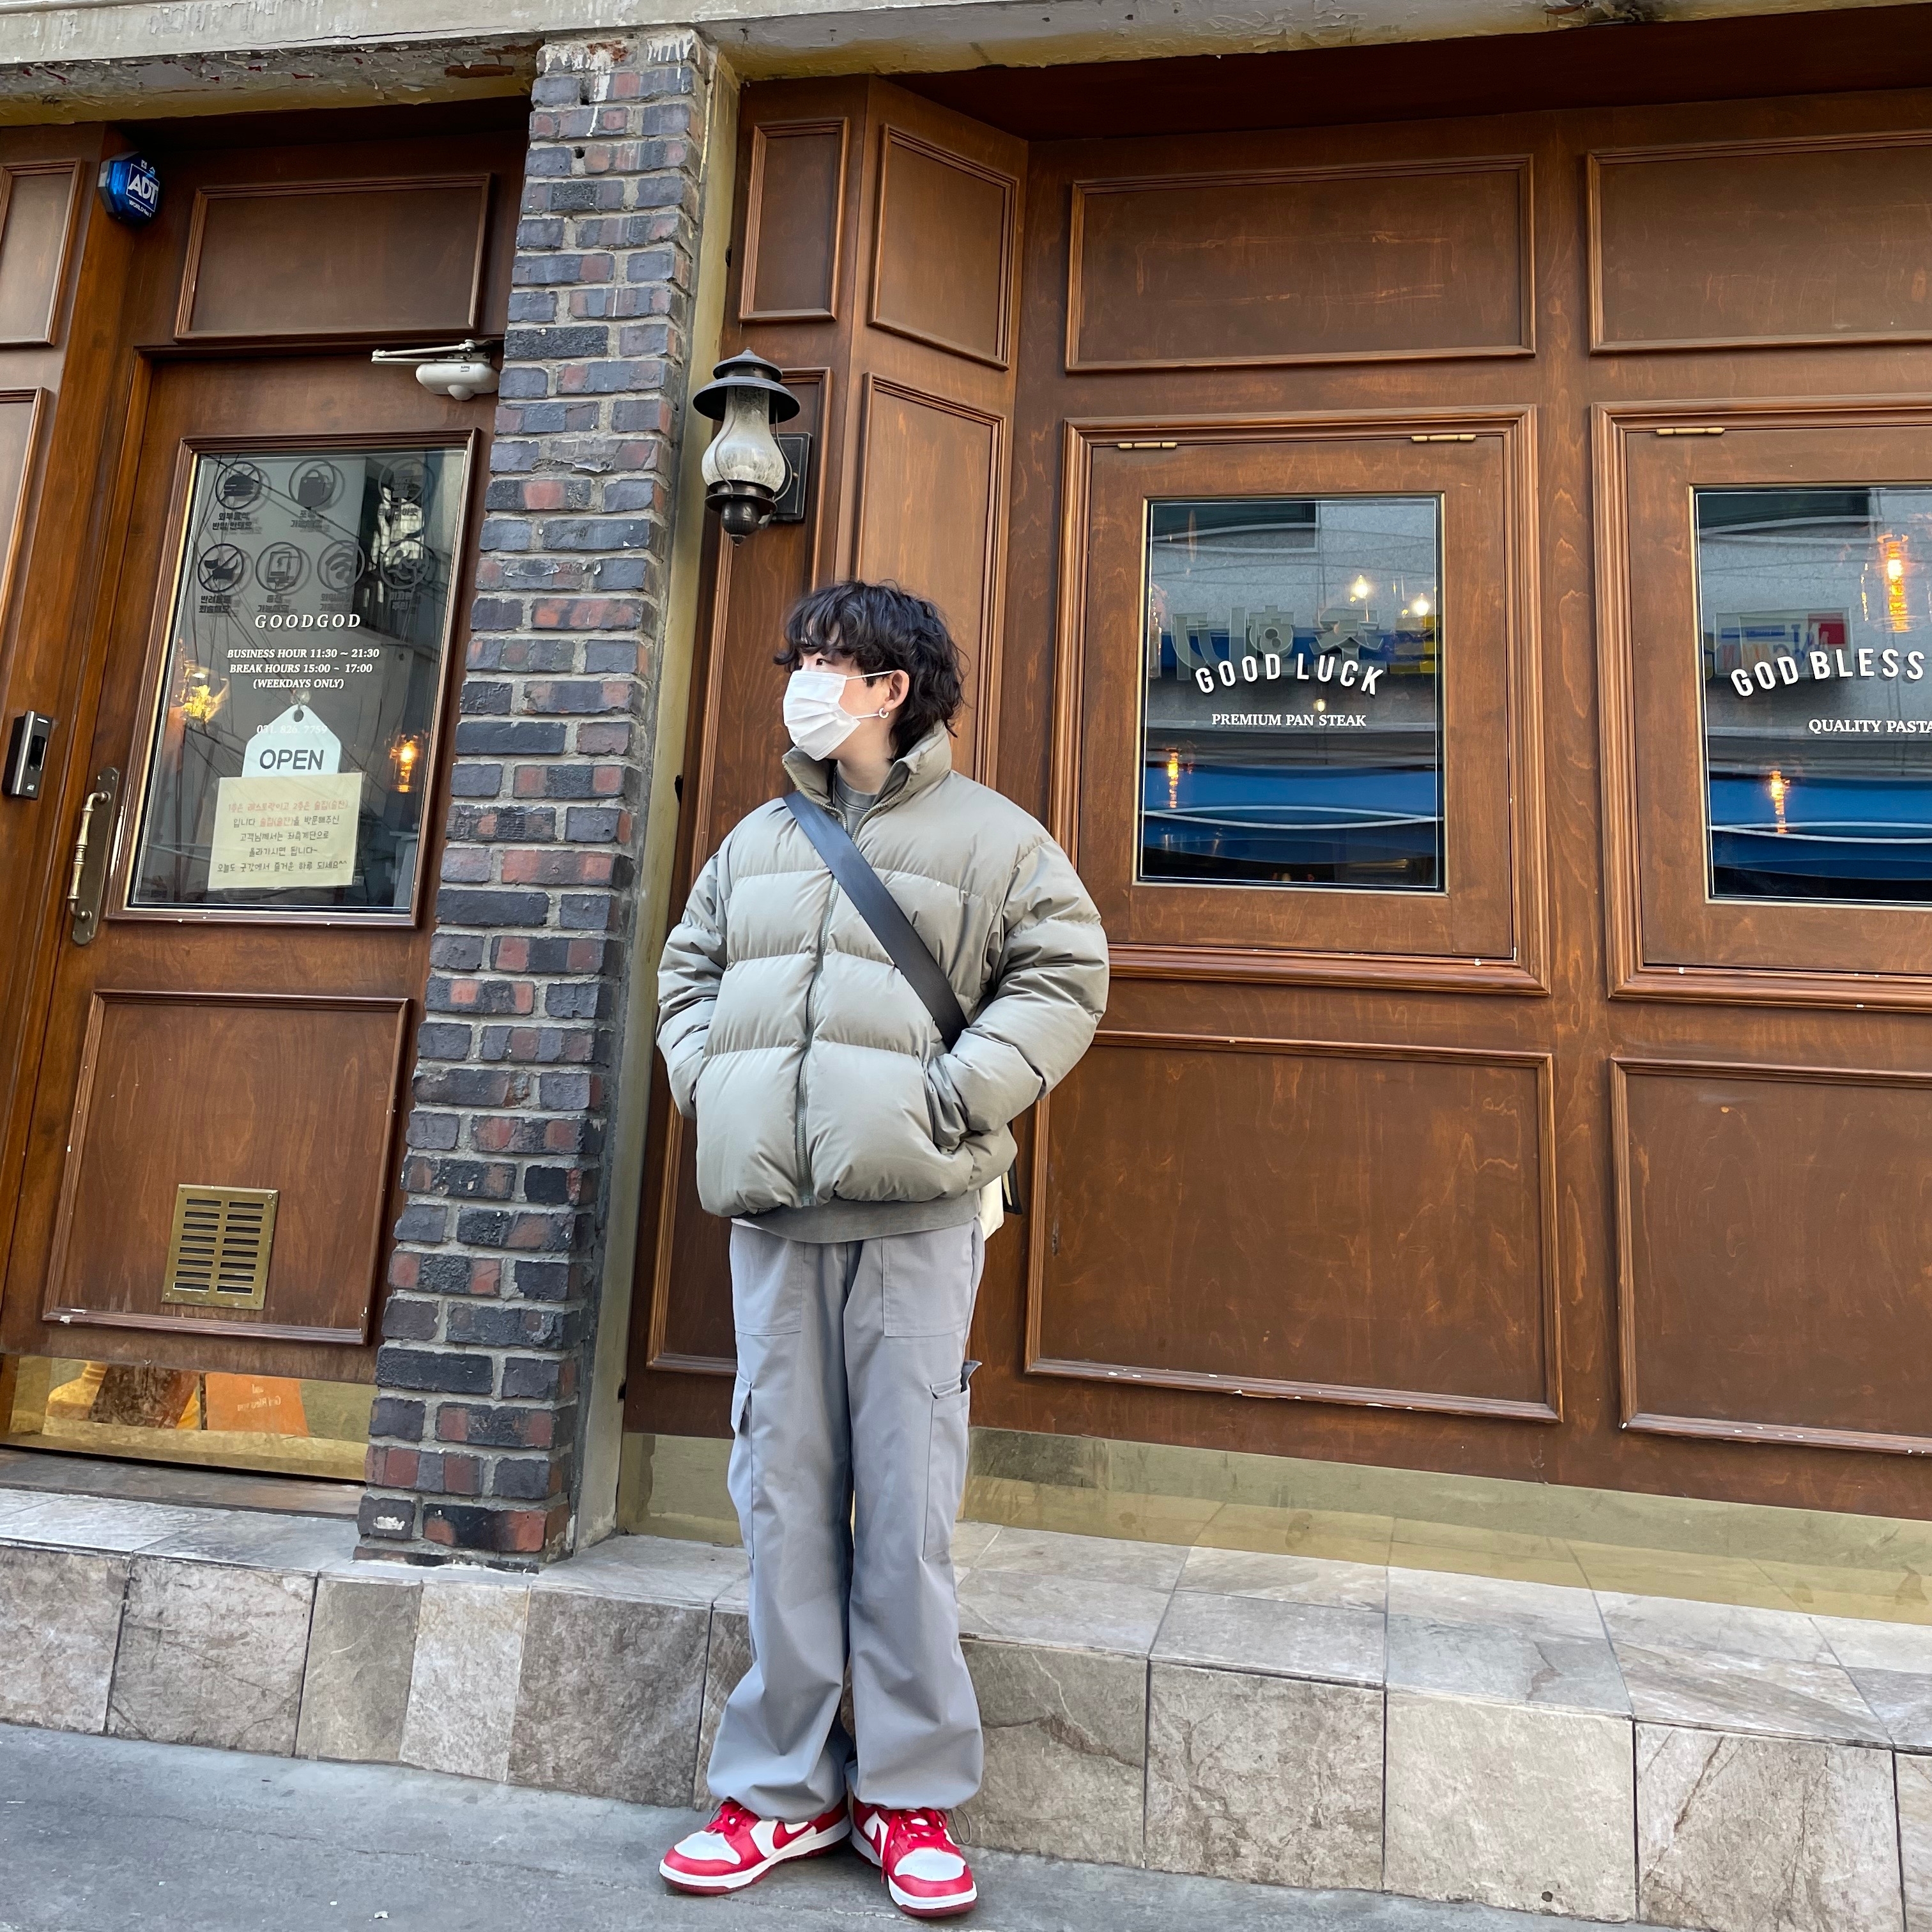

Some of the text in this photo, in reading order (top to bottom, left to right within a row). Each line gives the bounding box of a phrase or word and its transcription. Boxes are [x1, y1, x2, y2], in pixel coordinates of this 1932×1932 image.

[128, 174, 158, 204] ADT
[255, 614, 360, 629] GOODGOD
[227, 649, 275, 658] BUSINESS
[277, 649, 307, 658] HOUR
[310, 649, 337, 658] 11:30
[351, 649, 379, 658] 21:30
[229, 664, 263, 673] BREAK
[264, 664, 300, 673] HOURS
[303, 664, 330, 673] 15:00
[345, 664, 373, 673] 17:00
[1195, 653, 1384, 695] GOOD LUCK
[1730, 648, 1925, 696] GOD BLESS
[253, 678, 344, 689] (WEEKDAYS ONLY)
[1211, 714, 1367, 726] PREMIUM PAN STEAK
[1808, 719, 1882, 734] QUALITY
[259, 749, 324, 770] OPEN
[233, 818, 256, 827] 입니다
[304, 815, 340, 825] 방문해주신
[240, 831, 329, 842] 고객님께서는 좌측계단으로
[249, 847, 286, 857] 올라가시면
[217, 863, 235, 873] 오늘도
[240, 862, 270, 873] 굿갓에서
[274, 861, 294, 871] 즐거운
[299, 861, 312, 870] 하루
